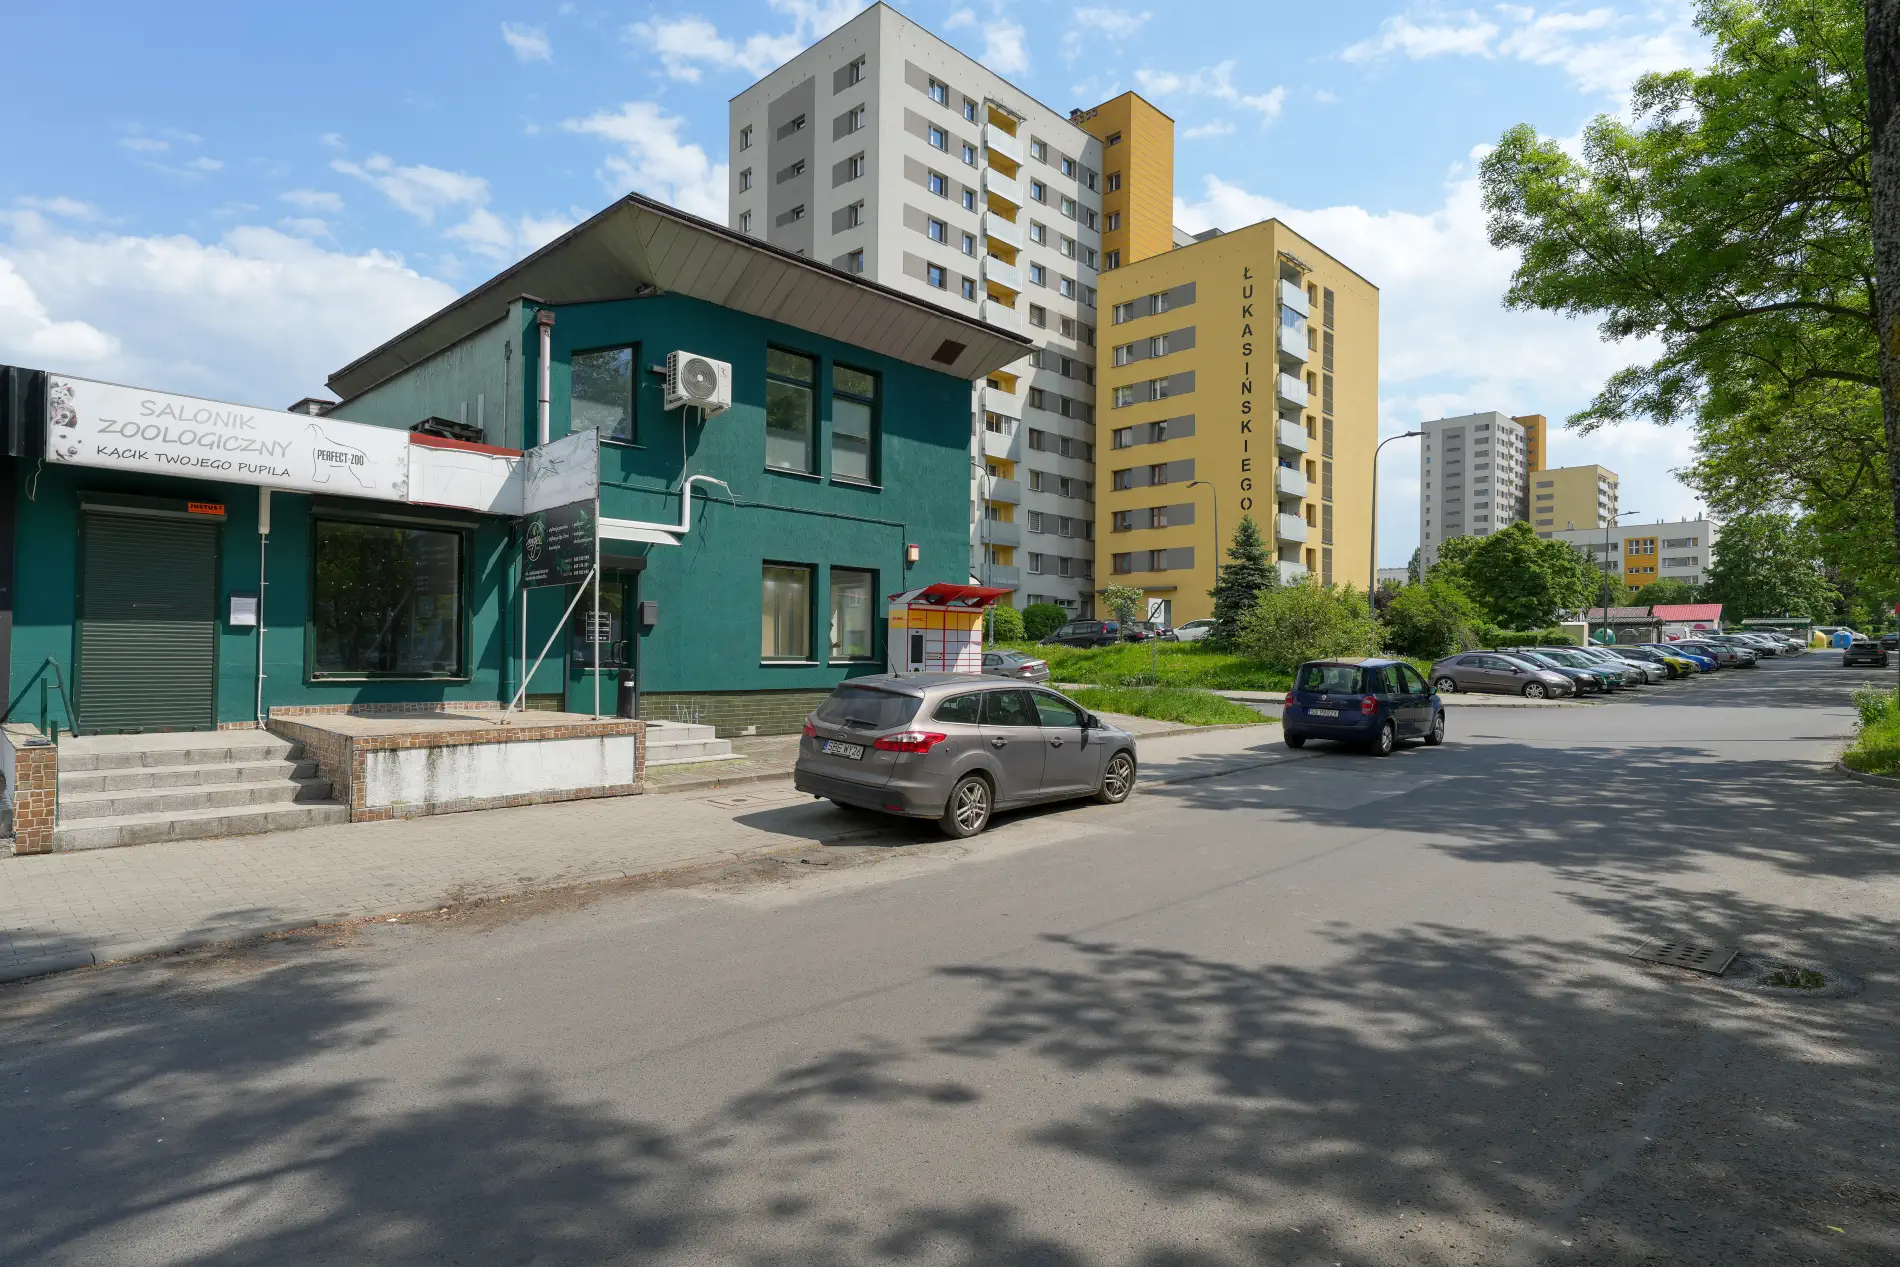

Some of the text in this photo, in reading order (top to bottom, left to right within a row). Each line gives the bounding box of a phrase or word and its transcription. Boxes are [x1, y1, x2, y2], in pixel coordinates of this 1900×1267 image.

[1240, 266, 1253, 511] ŁUKASIŃSKIEGO
[140, 399, 258, 431] SALONIK
[97, 418, 293, 459] ZOOLOGICZNY
[97, 445, 292, 477] KĄCIK TWOJEGO PUPILA
[317, 449, 364, 466] PERFECT-ZOO
